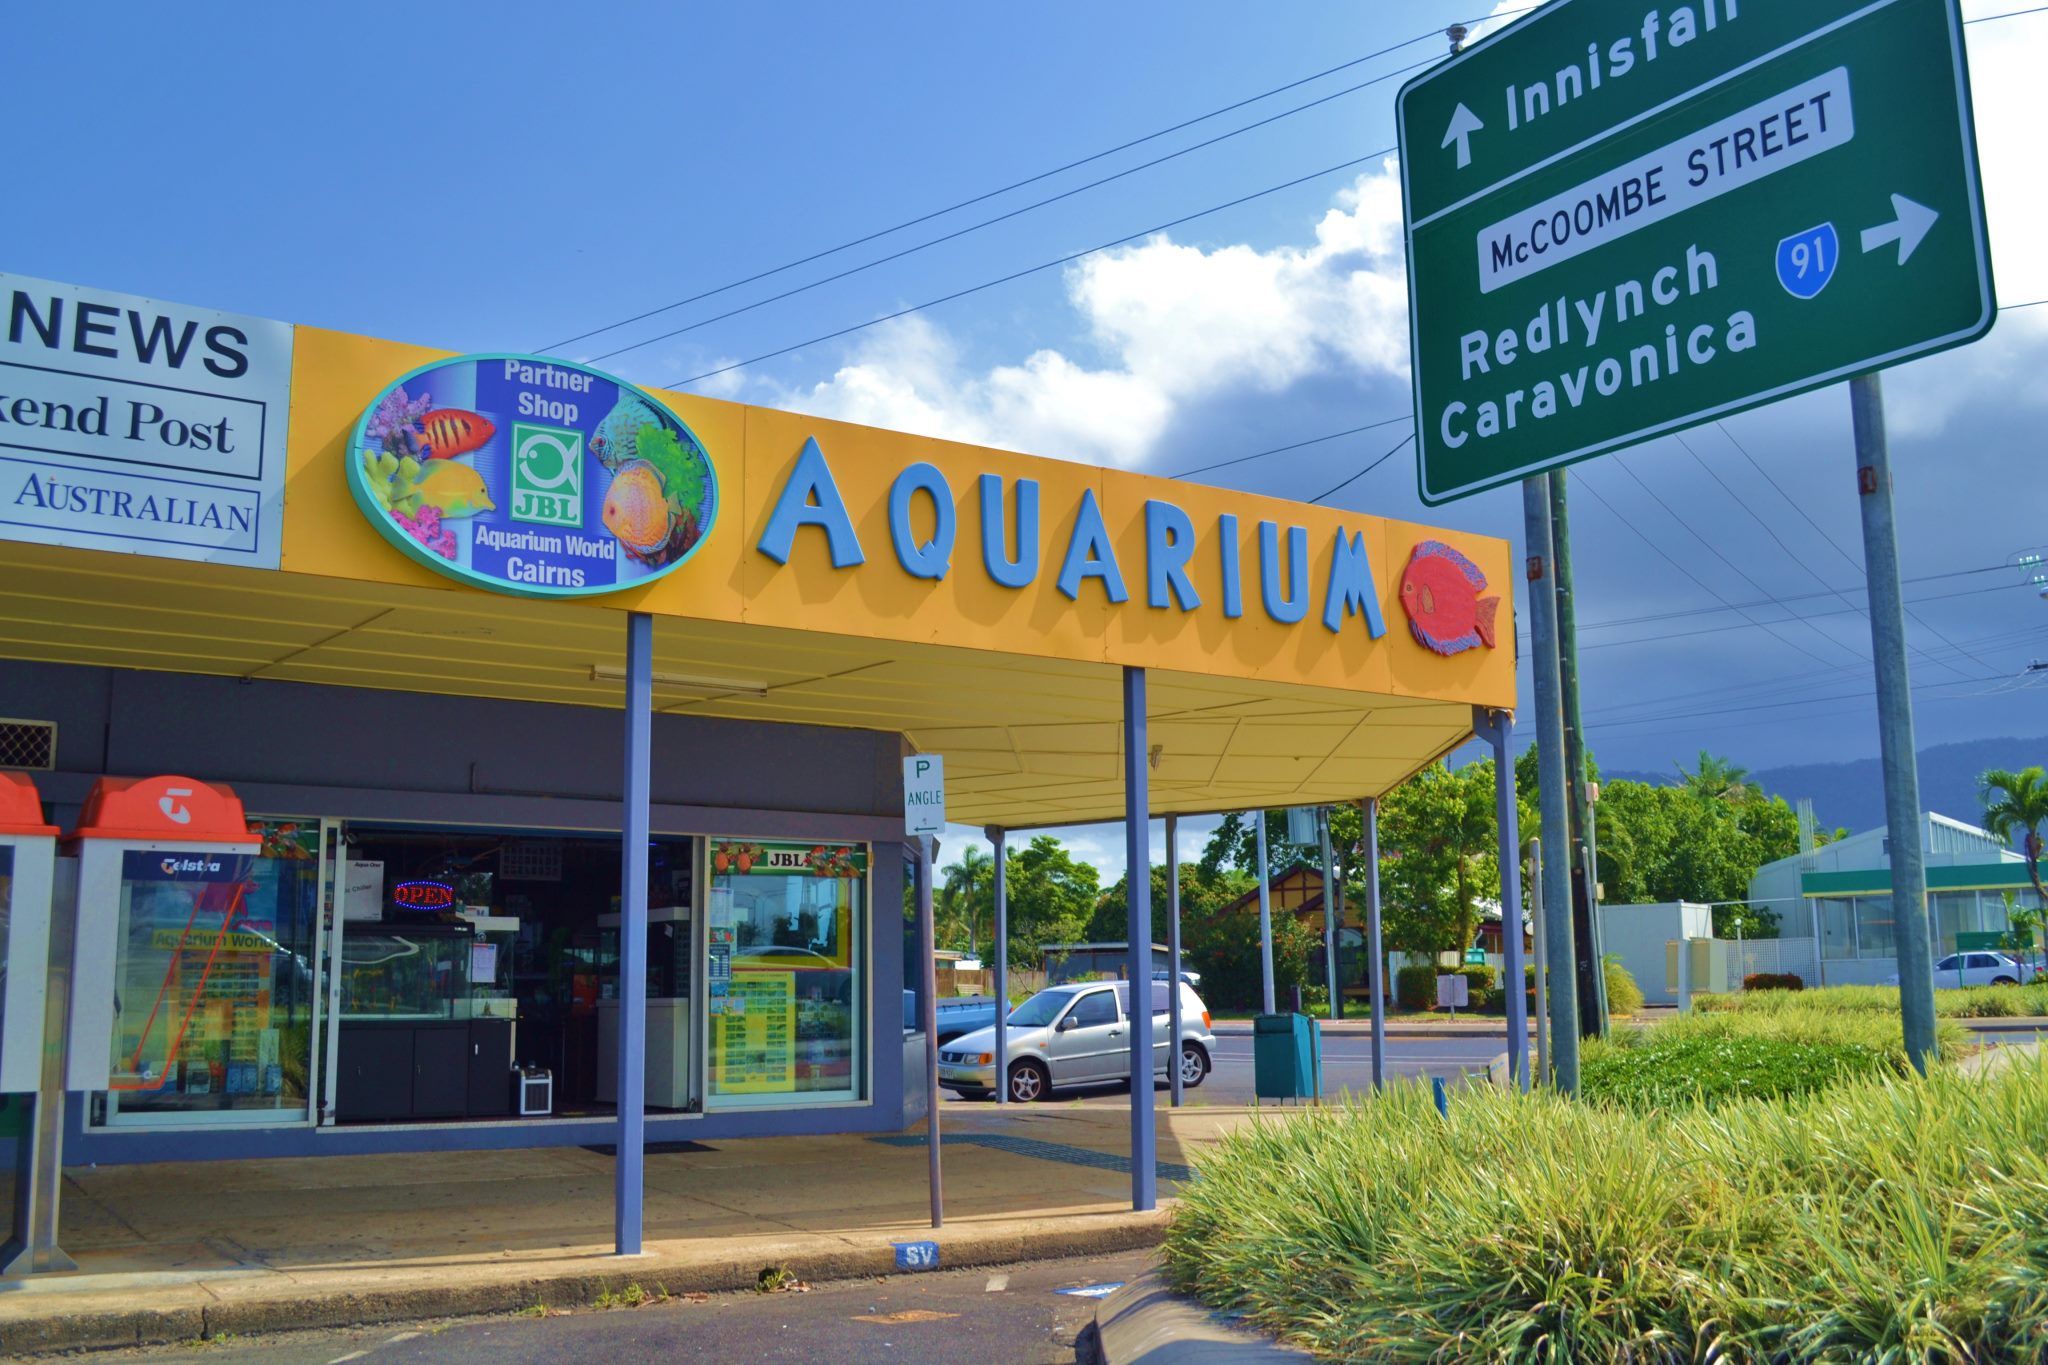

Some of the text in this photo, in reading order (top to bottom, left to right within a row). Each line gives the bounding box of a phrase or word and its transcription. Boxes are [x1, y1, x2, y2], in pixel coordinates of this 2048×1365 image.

[1491, 91, 1832, 273] McCOOMBE STREET
[1791, 236, 1825, 279] 91
[1460, 244, 1718, 381] Redlynch
[8, 290, 249, 378] NEWS
[504, 359, 593, 393] Partner
[1440, 310, 1757, 449] Caravonica
[518, 392, 579, 425] Shop
[124, 401, 235, 454] Post
[13, 473, 252, 533] AUSTRALIAN
[514, 493, 578, 521] JBL
[476, 525, 615, 560] Aquarium World
[756, 434, 1387, 641] AQUARIUM
[507, 556, 585, 588] Cairns
[916, 760, 930, 778] P
[908, 790, 942, 806] ANGLE
[161, 858, 220, 874] Telstra
[770, 853, 804, 866] JBL
[393, 887, 454, 904] OPEN
[155, 932, 227, 949] Aquarium
[907, 1247, 933, 1265] SV
